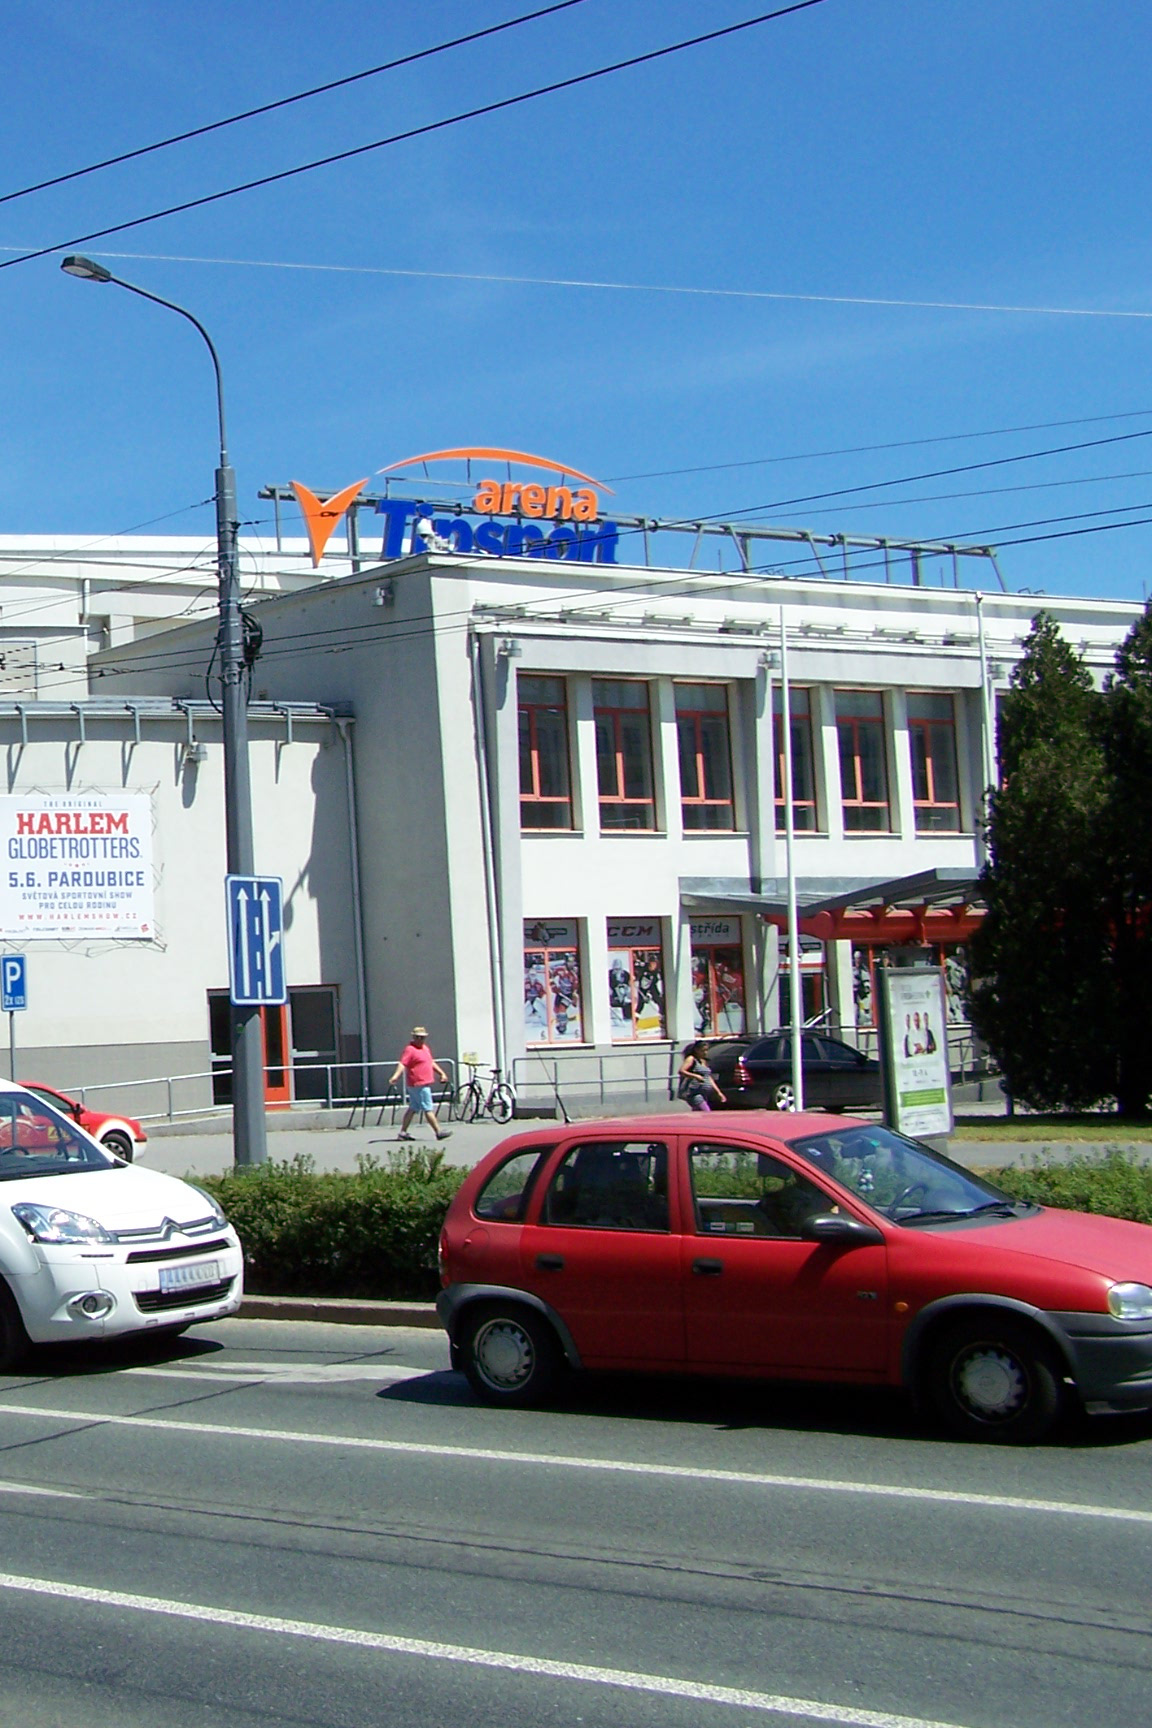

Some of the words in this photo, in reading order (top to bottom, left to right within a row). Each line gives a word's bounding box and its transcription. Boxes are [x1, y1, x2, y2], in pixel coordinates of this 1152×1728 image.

[473, 478, 598, 522] arena
[16, 812, 129, 835] HARLEM
[8, 837, 140, 859] GLOBETROTTERS
[9, 871, 42, 887] 5.6.
[48, 871, 145, 887] PARDUBICE
[22, 890, 59, 900] SVĚTOVÁ
[61, 890, 107, 900] SPORTOVNÍ
[109, 891, 133, 900] SHOW
[39, 901, 55, 909] PRO
[58, 901, 84, 909] CELOU
[86, 901, 117, 909] RODINU
[607, 926, 654, 937] CCM
[5, 961, 22, 993] P
